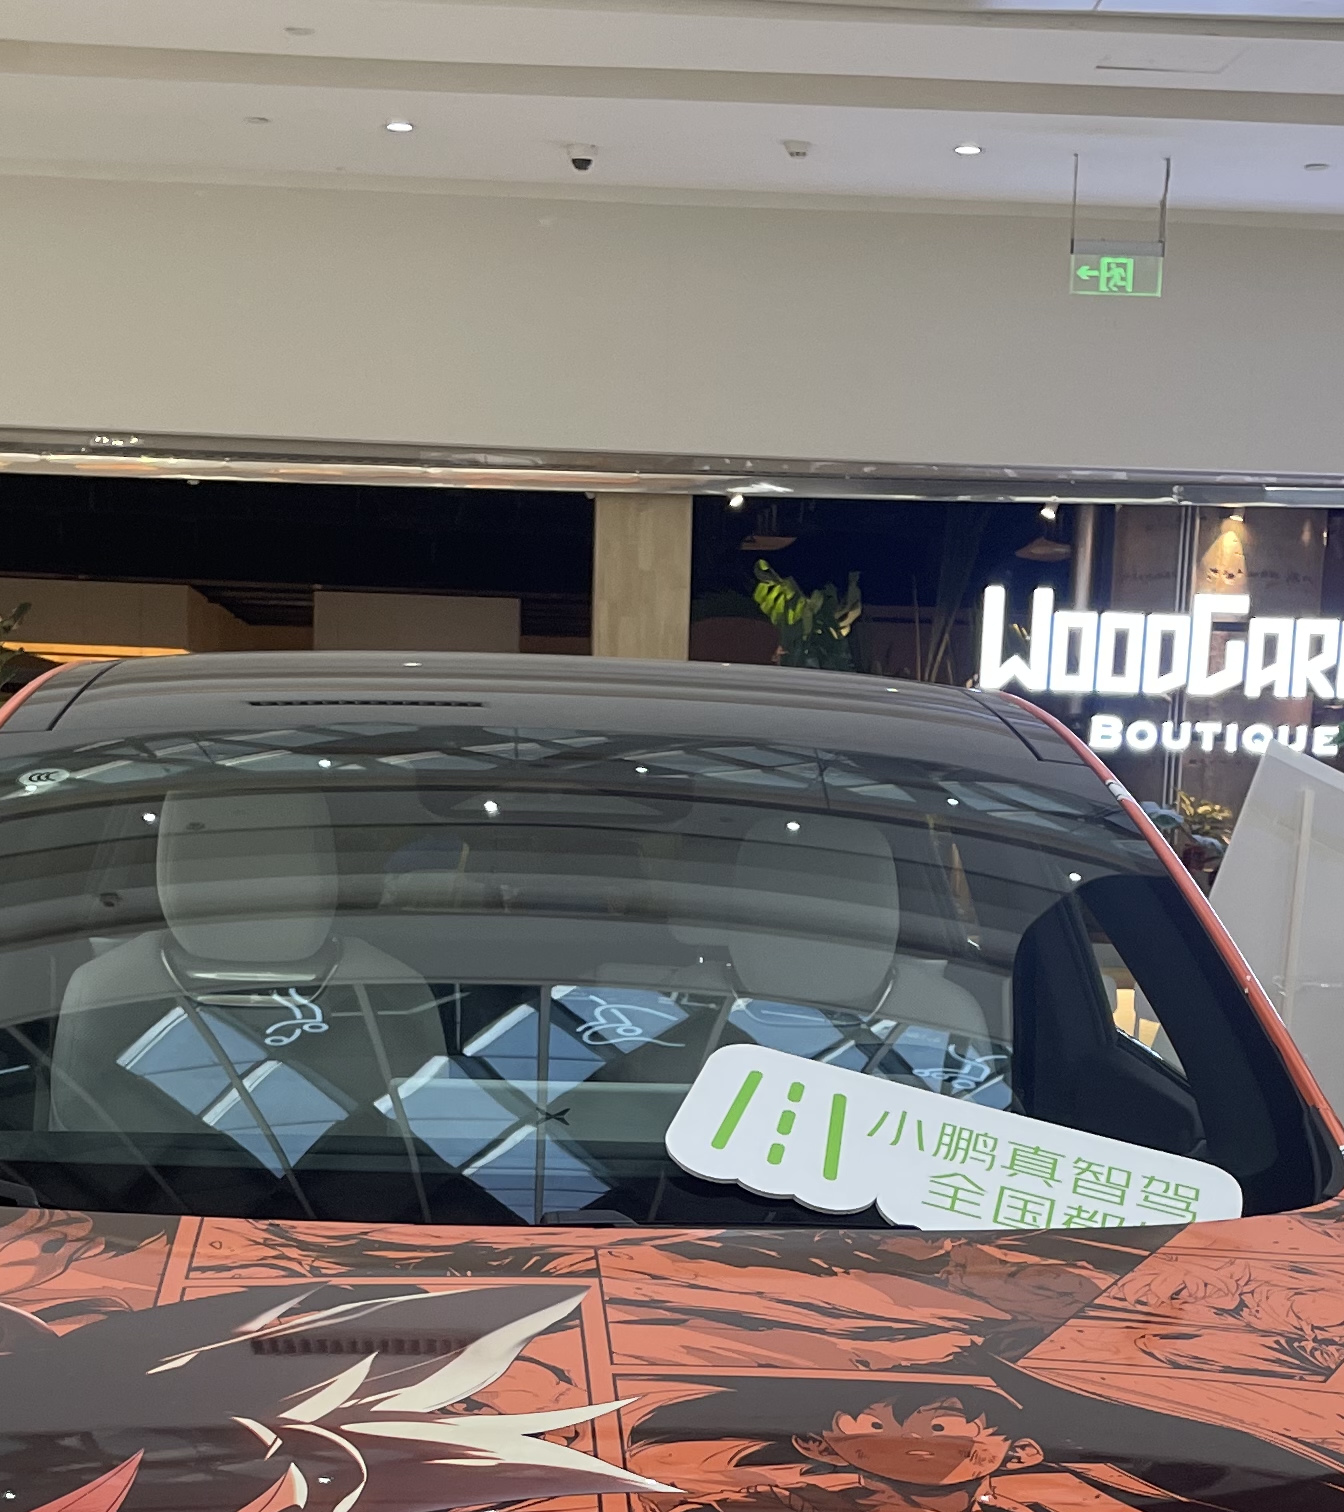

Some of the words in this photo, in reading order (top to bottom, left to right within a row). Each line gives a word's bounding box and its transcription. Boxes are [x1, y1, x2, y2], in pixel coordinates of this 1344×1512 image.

[1089, 713, 1341, 758] BOUTIQUE
[867, 1110, 1201, 1224] 小鹏真智驾
[920, 1172, 1147, 1230] 全国都
